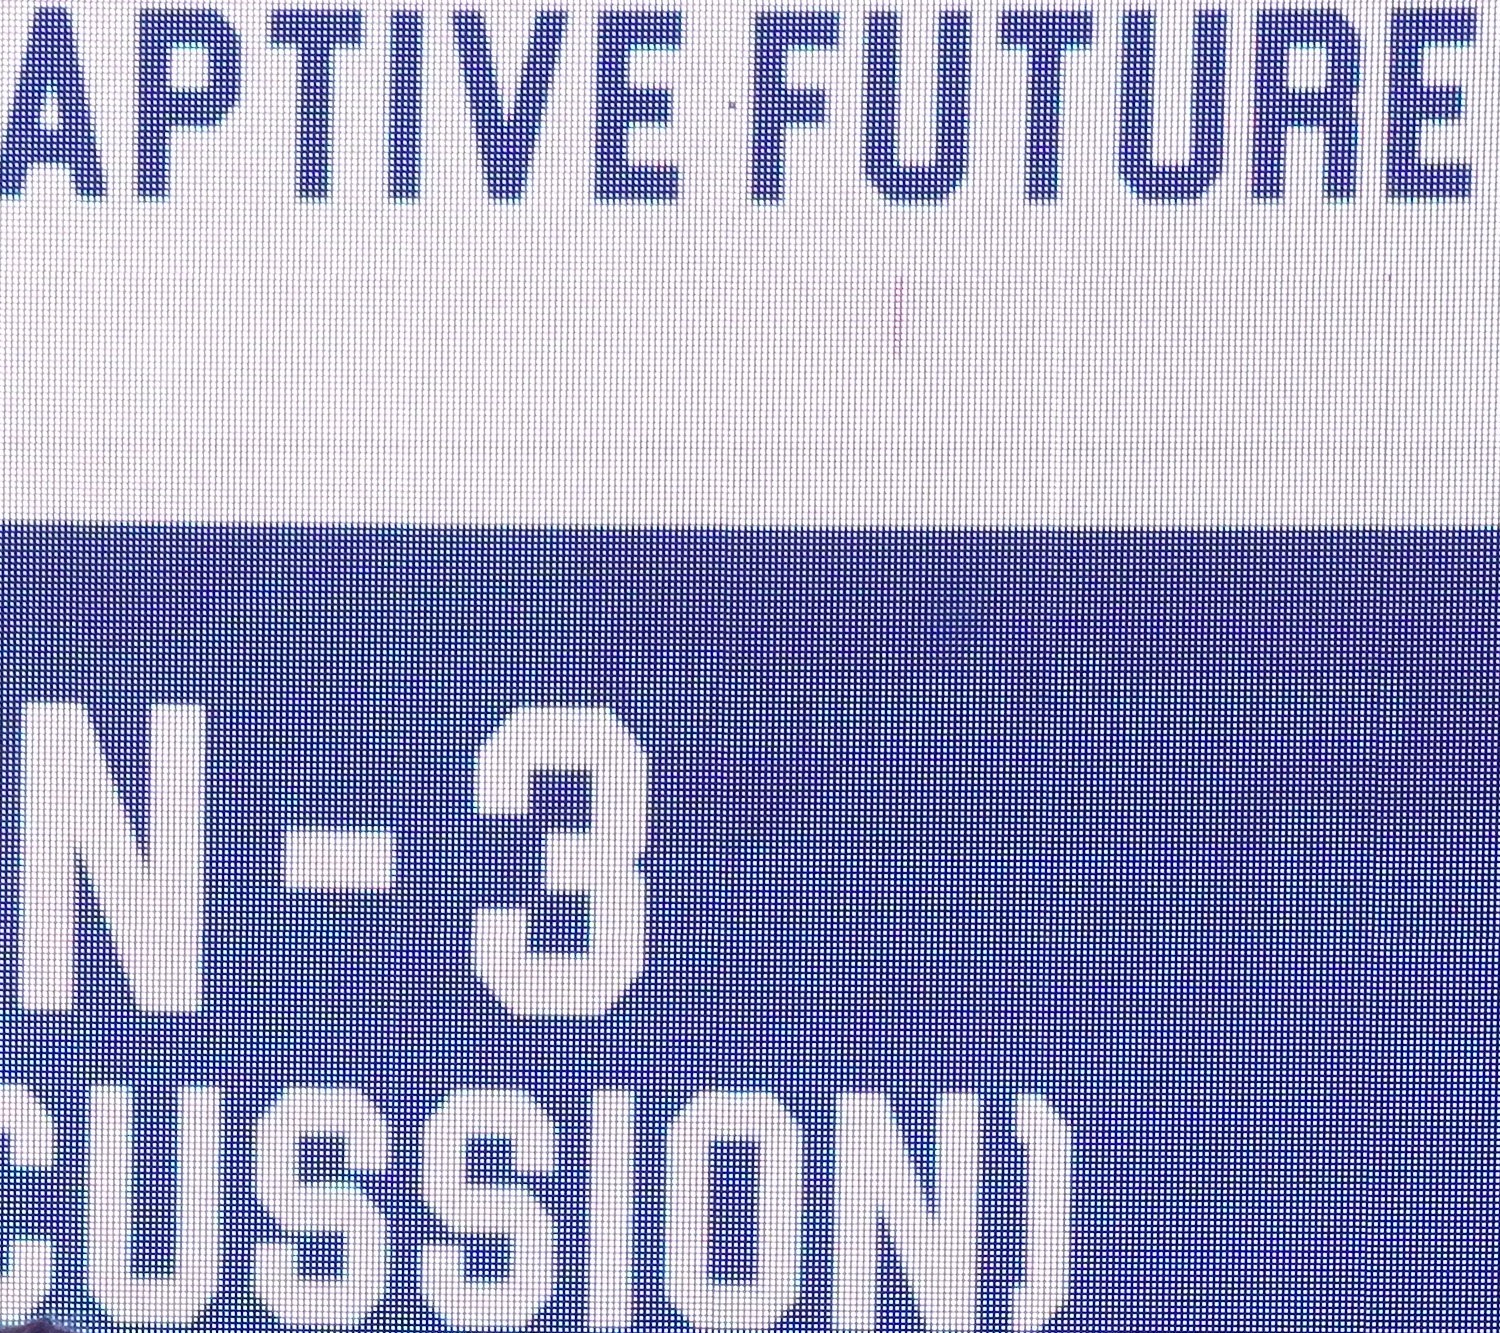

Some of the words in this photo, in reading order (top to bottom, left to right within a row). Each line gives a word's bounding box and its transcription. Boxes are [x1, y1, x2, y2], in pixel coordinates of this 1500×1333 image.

[749, 5, 1479, 205] FUTURE
[286, 833, 391, 887] -
[476, 710, 644, 1012] 3
